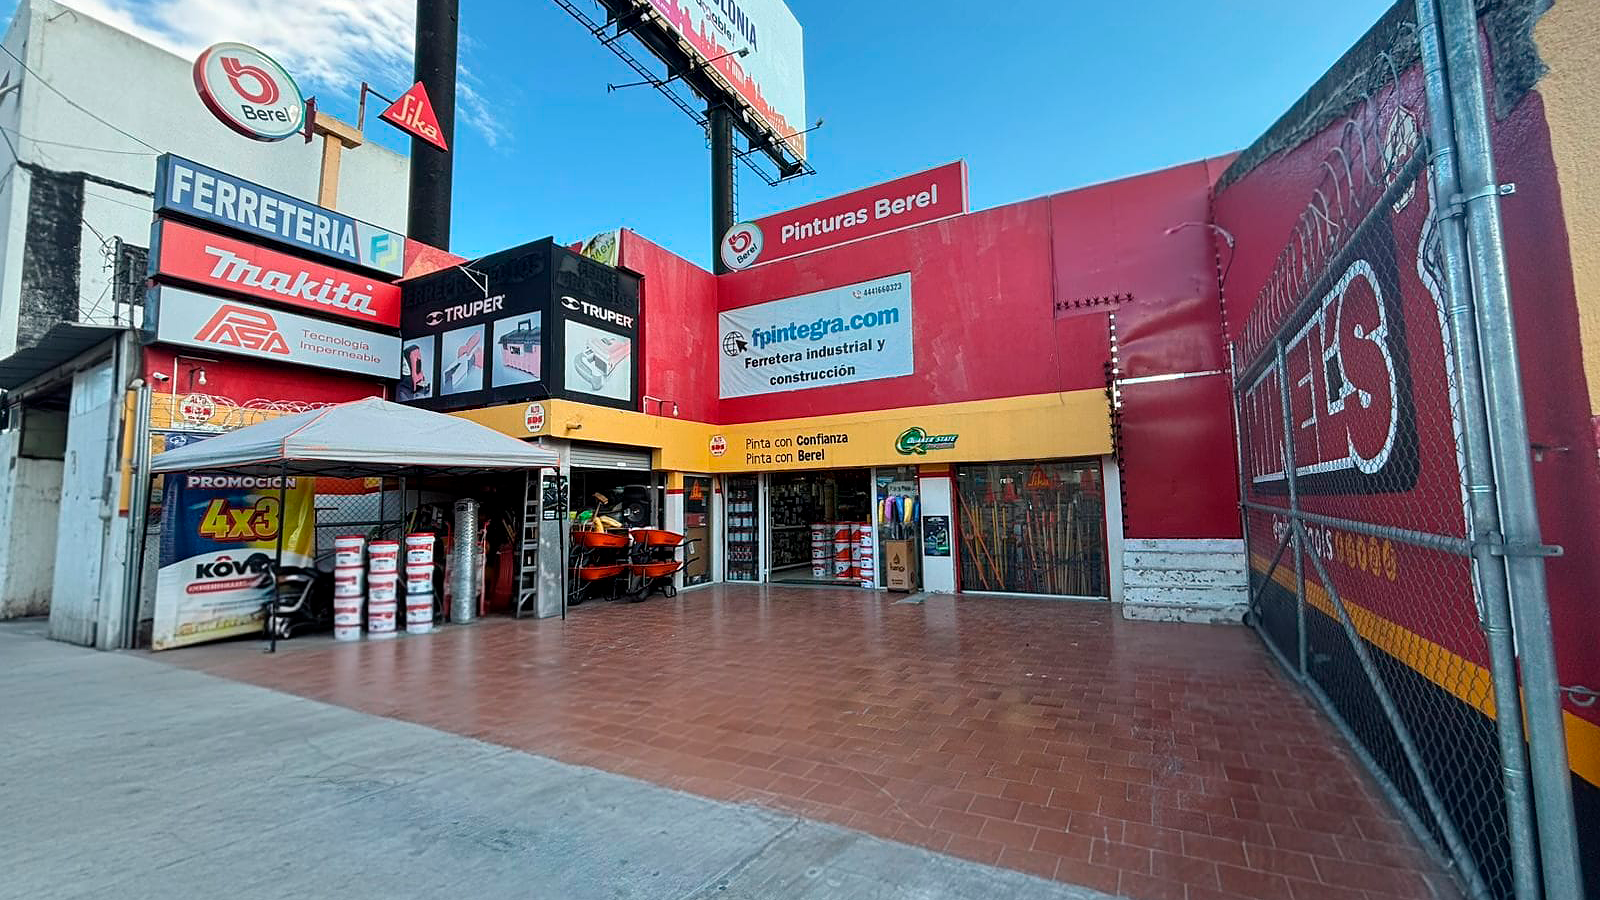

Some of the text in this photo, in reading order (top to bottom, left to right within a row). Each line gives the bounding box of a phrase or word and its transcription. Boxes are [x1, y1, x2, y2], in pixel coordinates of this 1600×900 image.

[241, 104, 290, 123] Berel
[392, 95, 438, 140] Sika
[171, 164, 356, 257] FERRETERIA
[781, 184, 938, 244] Pinturas Berel
[736, 243, 758, 264] Berel
[863, 282, 902, 296] 4441660323
[444, 295, 504, 322] TRUPER
[580, 301, 633, 329] TRUPER
[194, 305, 292, 355] PASA
[302, 329, 370, 351] Tecnología
[752, 307, 899, 349] fpintegra.com
[300, 341, 381, 364] Impermeable
[744, 339, 886, 369] Ferretera industrial y
[769, 364, 856, 386] construcción
[745, 433, 848, 449] Pinta con Confianza
[746, 449, 825, 465] Pinta con Berel
